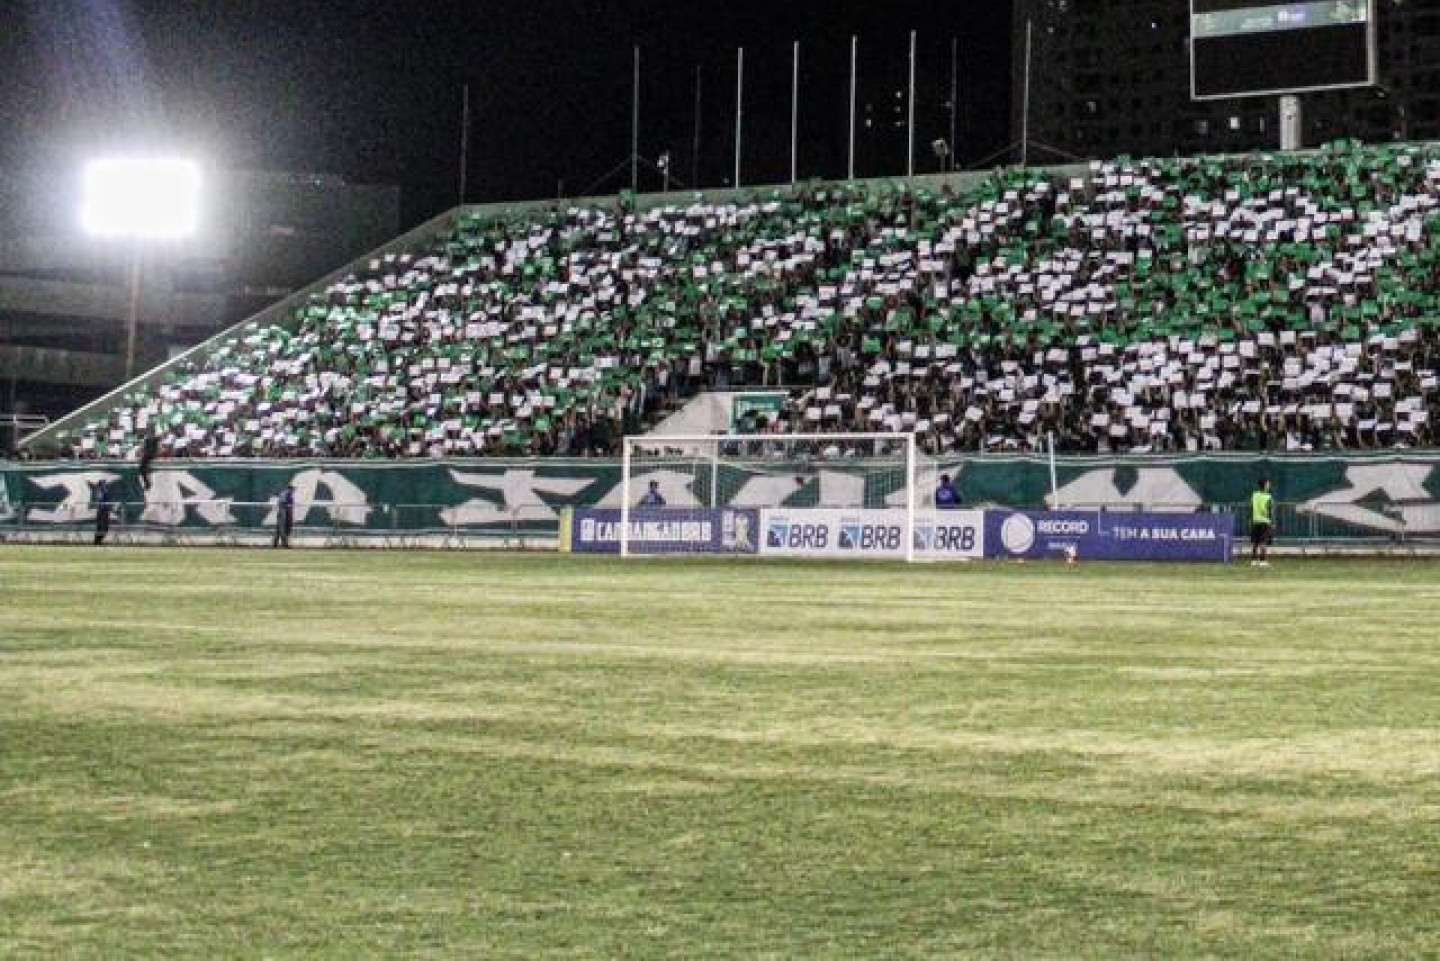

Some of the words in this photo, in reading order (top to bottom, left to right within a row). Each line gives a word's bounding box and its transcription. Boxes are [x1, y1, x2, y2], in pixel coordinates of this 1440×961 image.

[788, 524, 828, 548] BRB
[1037, 520, 1089, 534] RECORD
[1113, 527, 1137, 539] TEM
[1139, 528, 1149, 539] A
[1151, 528, 1178, 539] SUA
[1180, 528, 1216, 540] CARA
[861, 525, 901, 549] BRB
